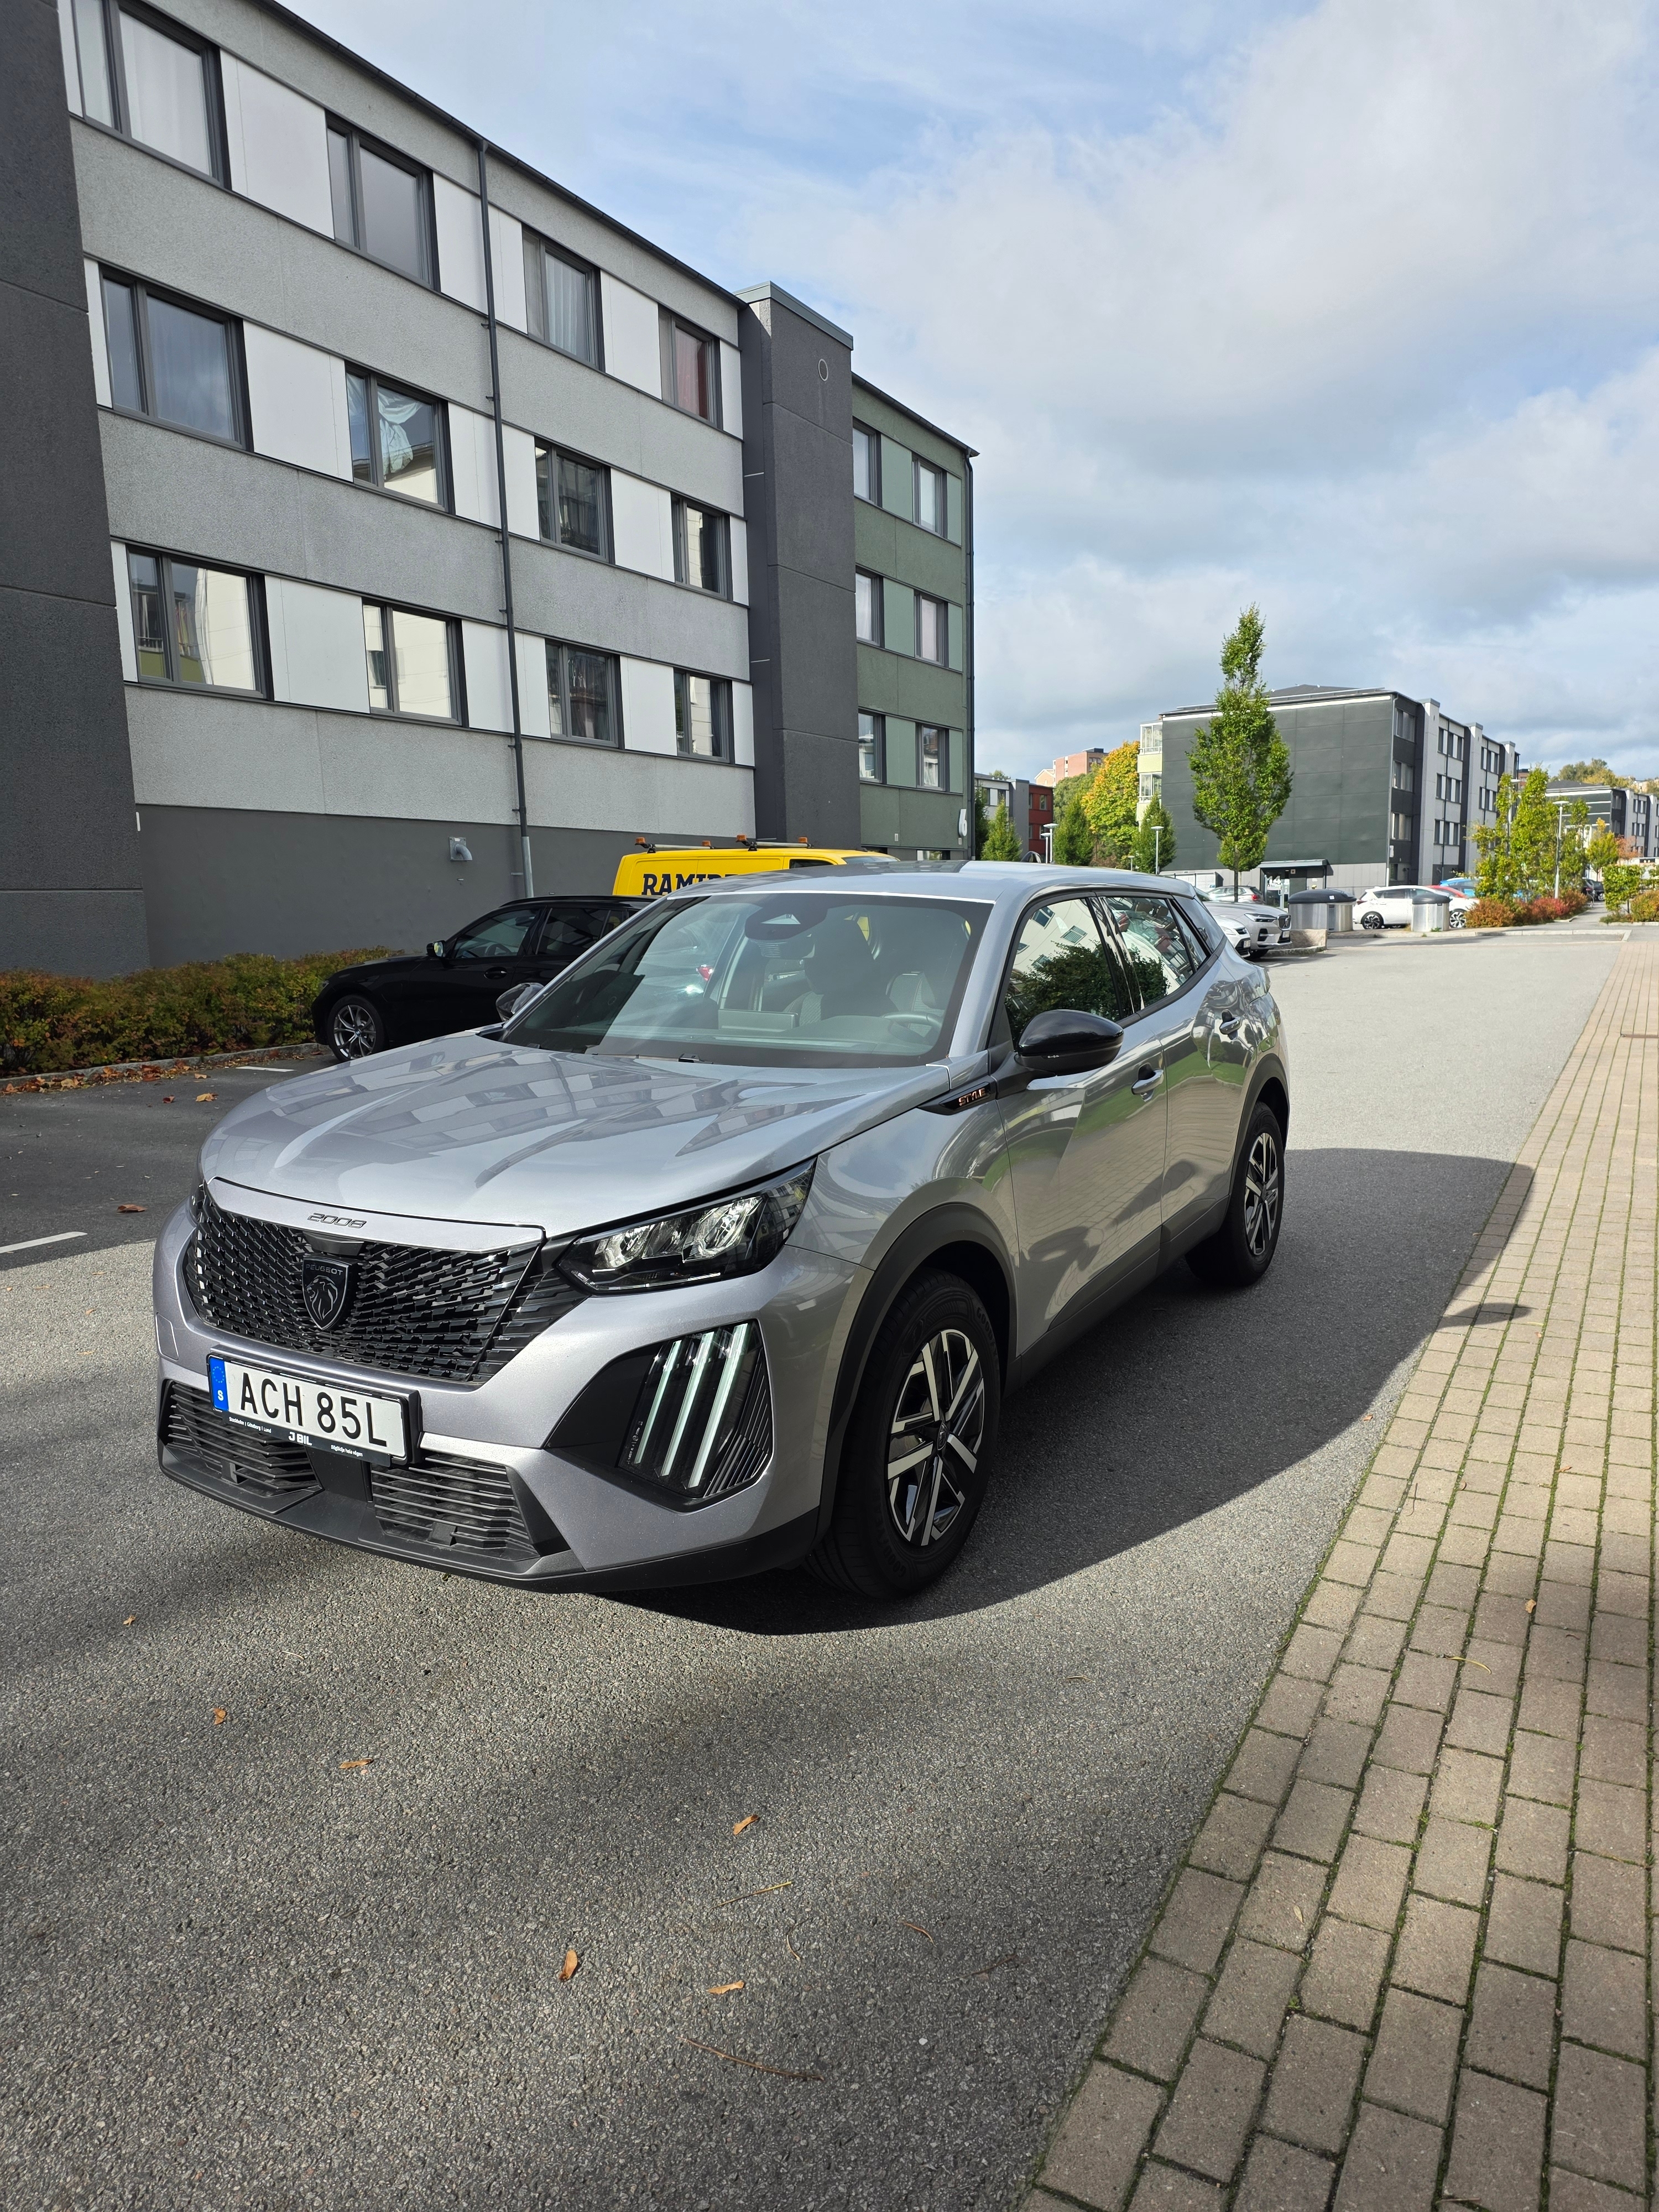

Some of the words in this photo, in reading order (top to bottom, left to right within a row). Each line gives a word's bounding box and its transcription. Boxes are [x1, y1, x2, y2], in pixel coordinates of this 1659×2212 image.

[958, 808, 967, 836] 6
[958, 1088, 987, 1106] STYLE
[307, 1213, 367, 1228] 2008
[306, 1264, 343, 1276] PEUGEOT
[217, 1390, 224, 1401] S
[240, 1373, 304, 1427] ACH
[317, 1392, 387, 1447] 85L
[288, 1431, 295, 1441] J
[296, 1433, 312, 1446] BIL
